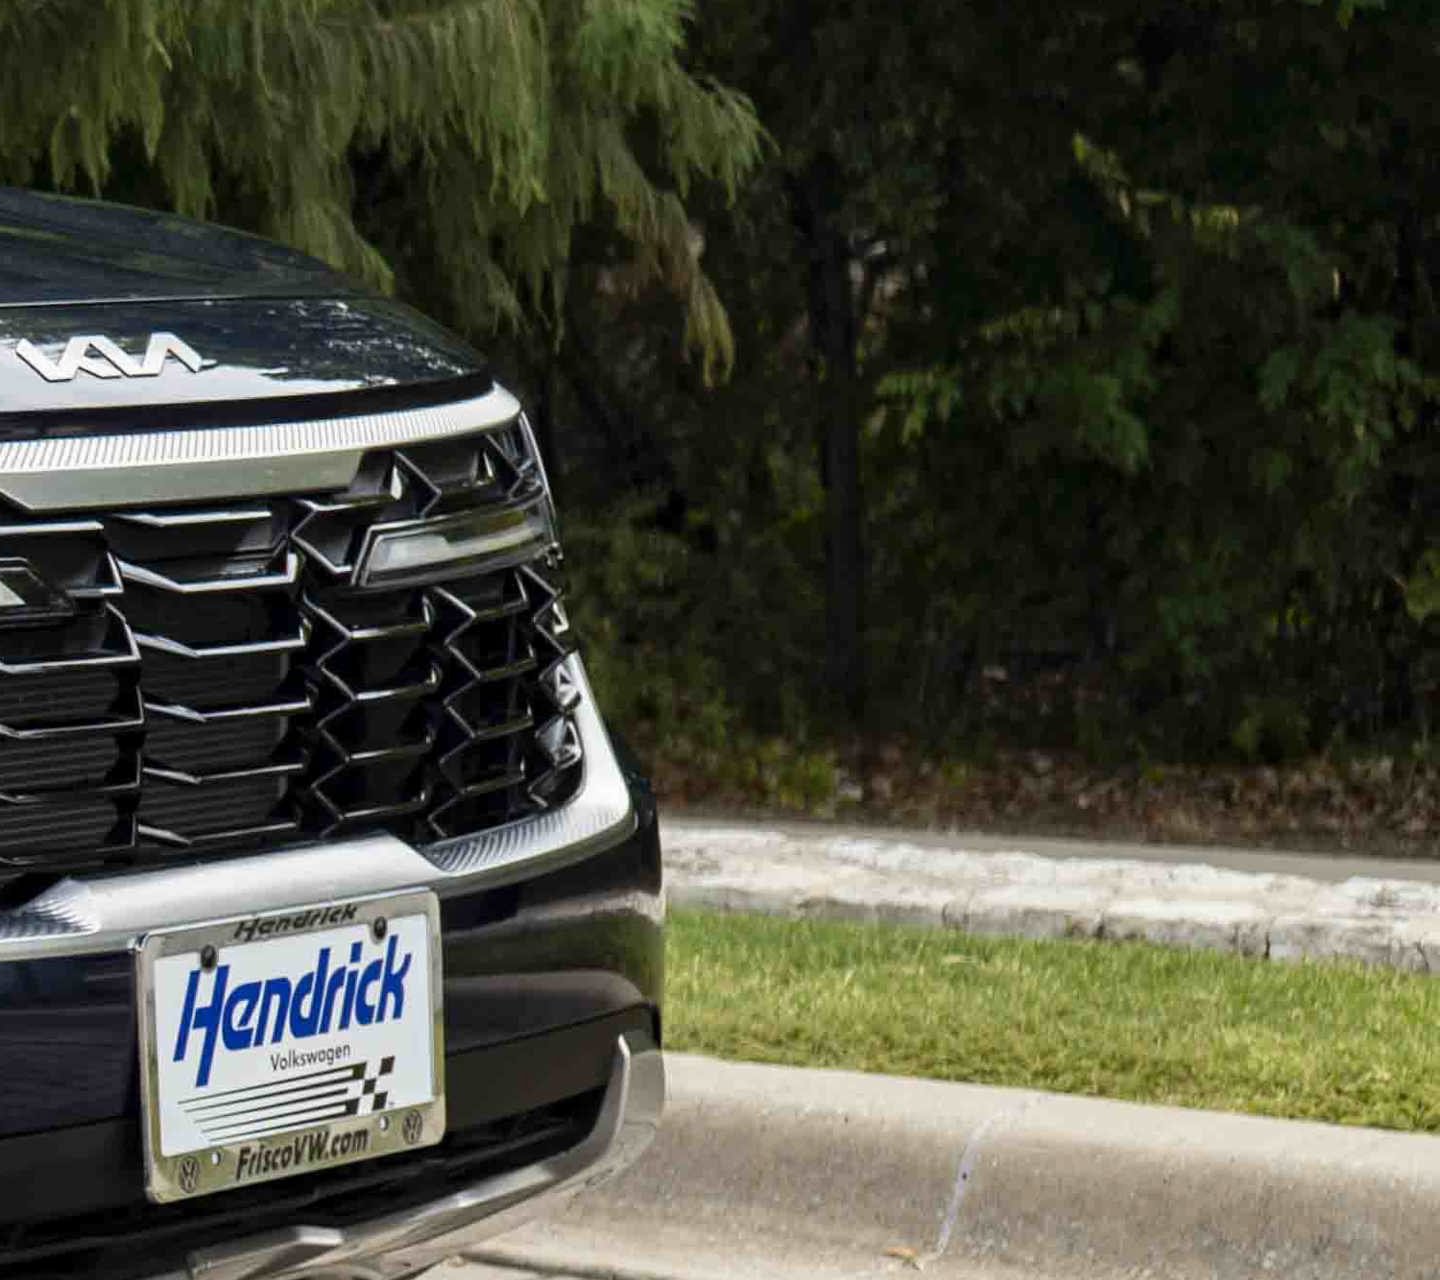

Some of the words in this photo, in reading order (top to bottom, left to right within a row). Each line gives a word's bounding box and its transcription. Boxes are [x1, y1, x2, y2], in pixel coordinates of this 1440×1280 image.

[15, 330, 204, 383] KIA
[233, 903, 358, 938] Hendrick
[173, 934, 412, 1088] Hendrick
[270, 1043, 351, 1072] Volkswagen
[236, 1127, 369, 1181] FriscoVW.com
